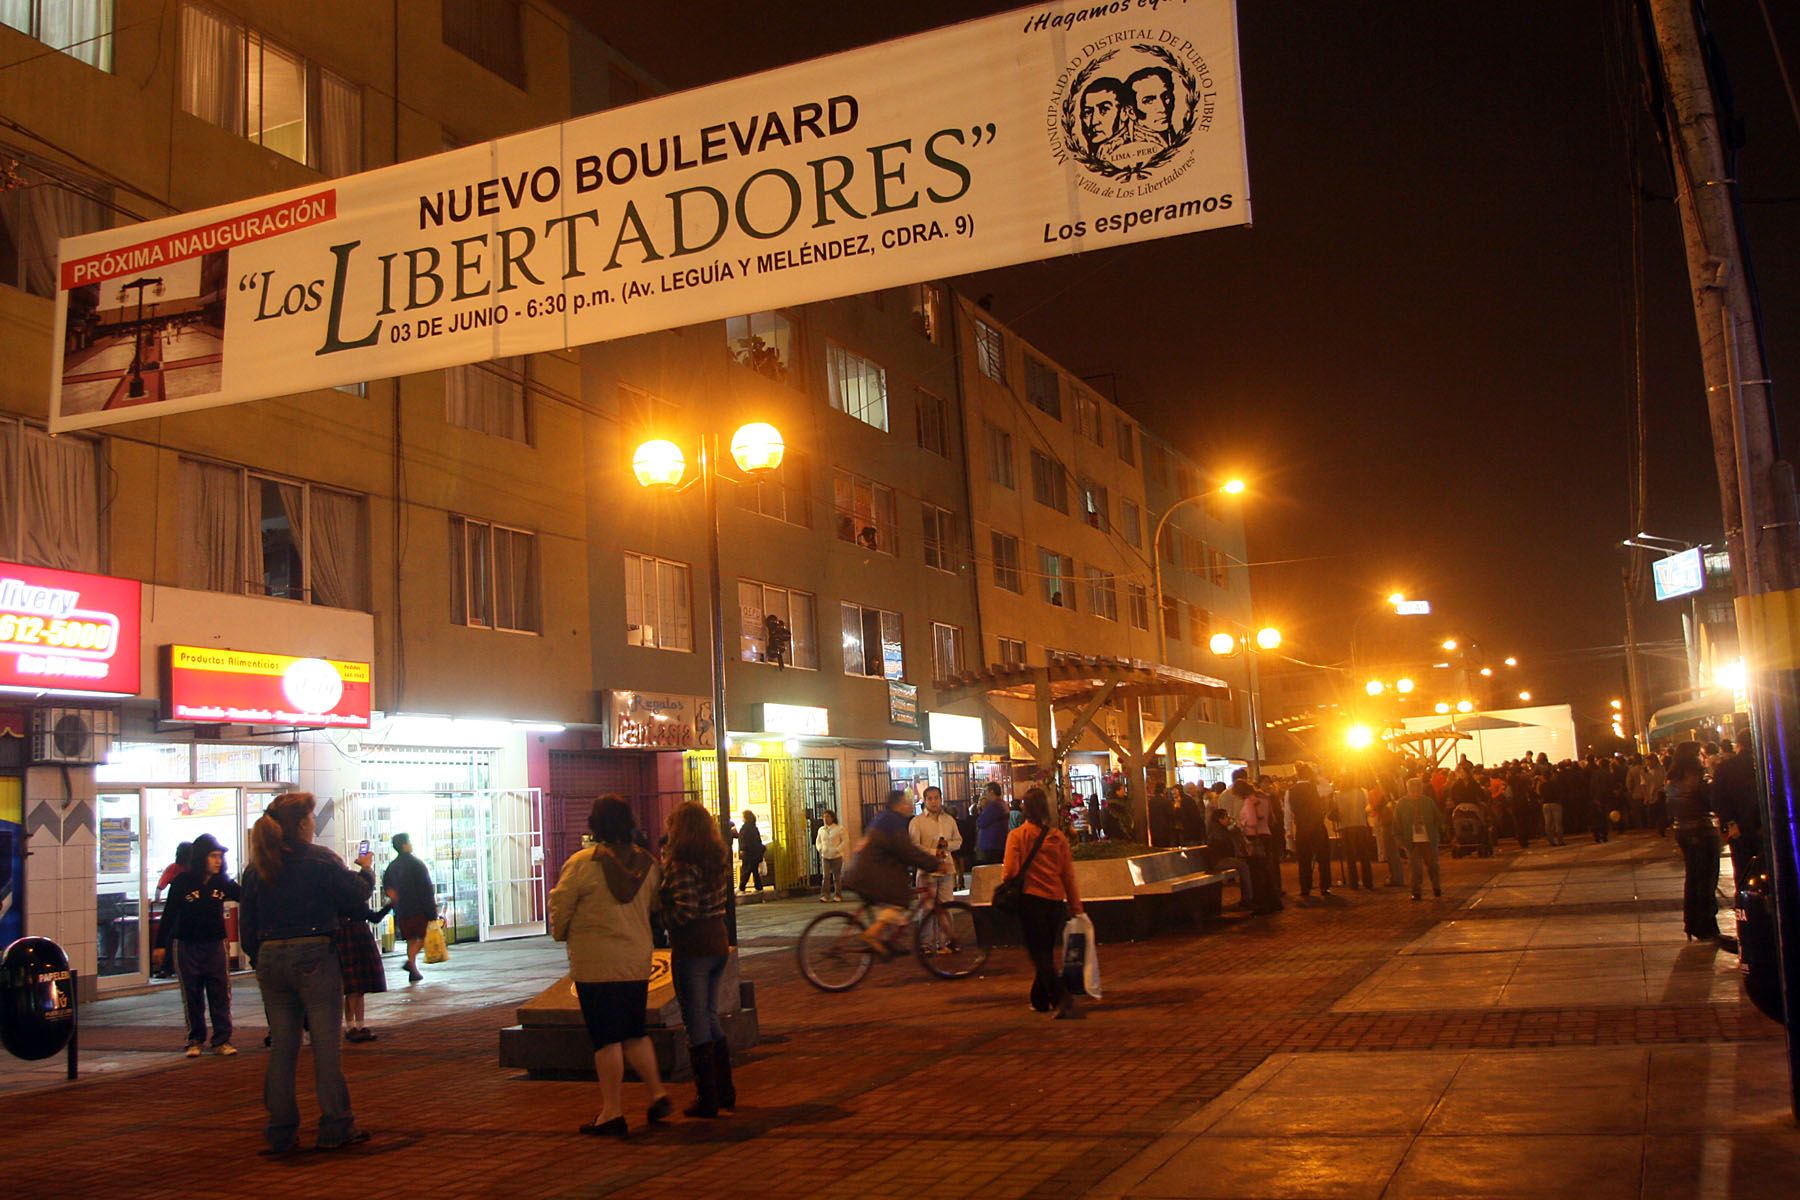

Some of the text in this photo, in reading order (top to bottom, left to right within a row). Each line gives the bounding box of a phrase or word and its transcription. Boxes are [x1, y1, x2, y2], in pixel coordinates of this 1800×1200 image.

[1046, 57, 1082, 166] MUNICIPALIDAD
[1082, 29, 1154, 58] DISTRITAL
[1179, 41, 1213, 88] PUEBLO
[1199, 91, 1217, 132] LIBRE
[418, 94, 859, 230] NUEVO BOULEVARD
[1111, 152, 1131, 162] LIMA
[1043, 192, 1233, 243] Los esperamos
[1101, 187, 1115, 198] de
[1116, 187, 1135, 199] Los
[73, 198, 327, 284] PRÓXIMA INAUGURACIÓN
[390, 323, 412, 343] 03
[417, 318, 443, 340] DE
[448, 304, 509, 333] JUNIO
[527, 294, 567, 318] 6:30
[573, 288, 615, 315] p.m.
[621, 277, 655, 305] (Av.
[661, 259, 734, 292] LEGUÍA
[738, 257, 752, 278] Y
[757, 234, 876, 275] MELÉNDEZ,
[882, 220, 948, 250] CDRA.
[955, 214, 975, 239] 9)
[180, 652, 225, 665] Productos
